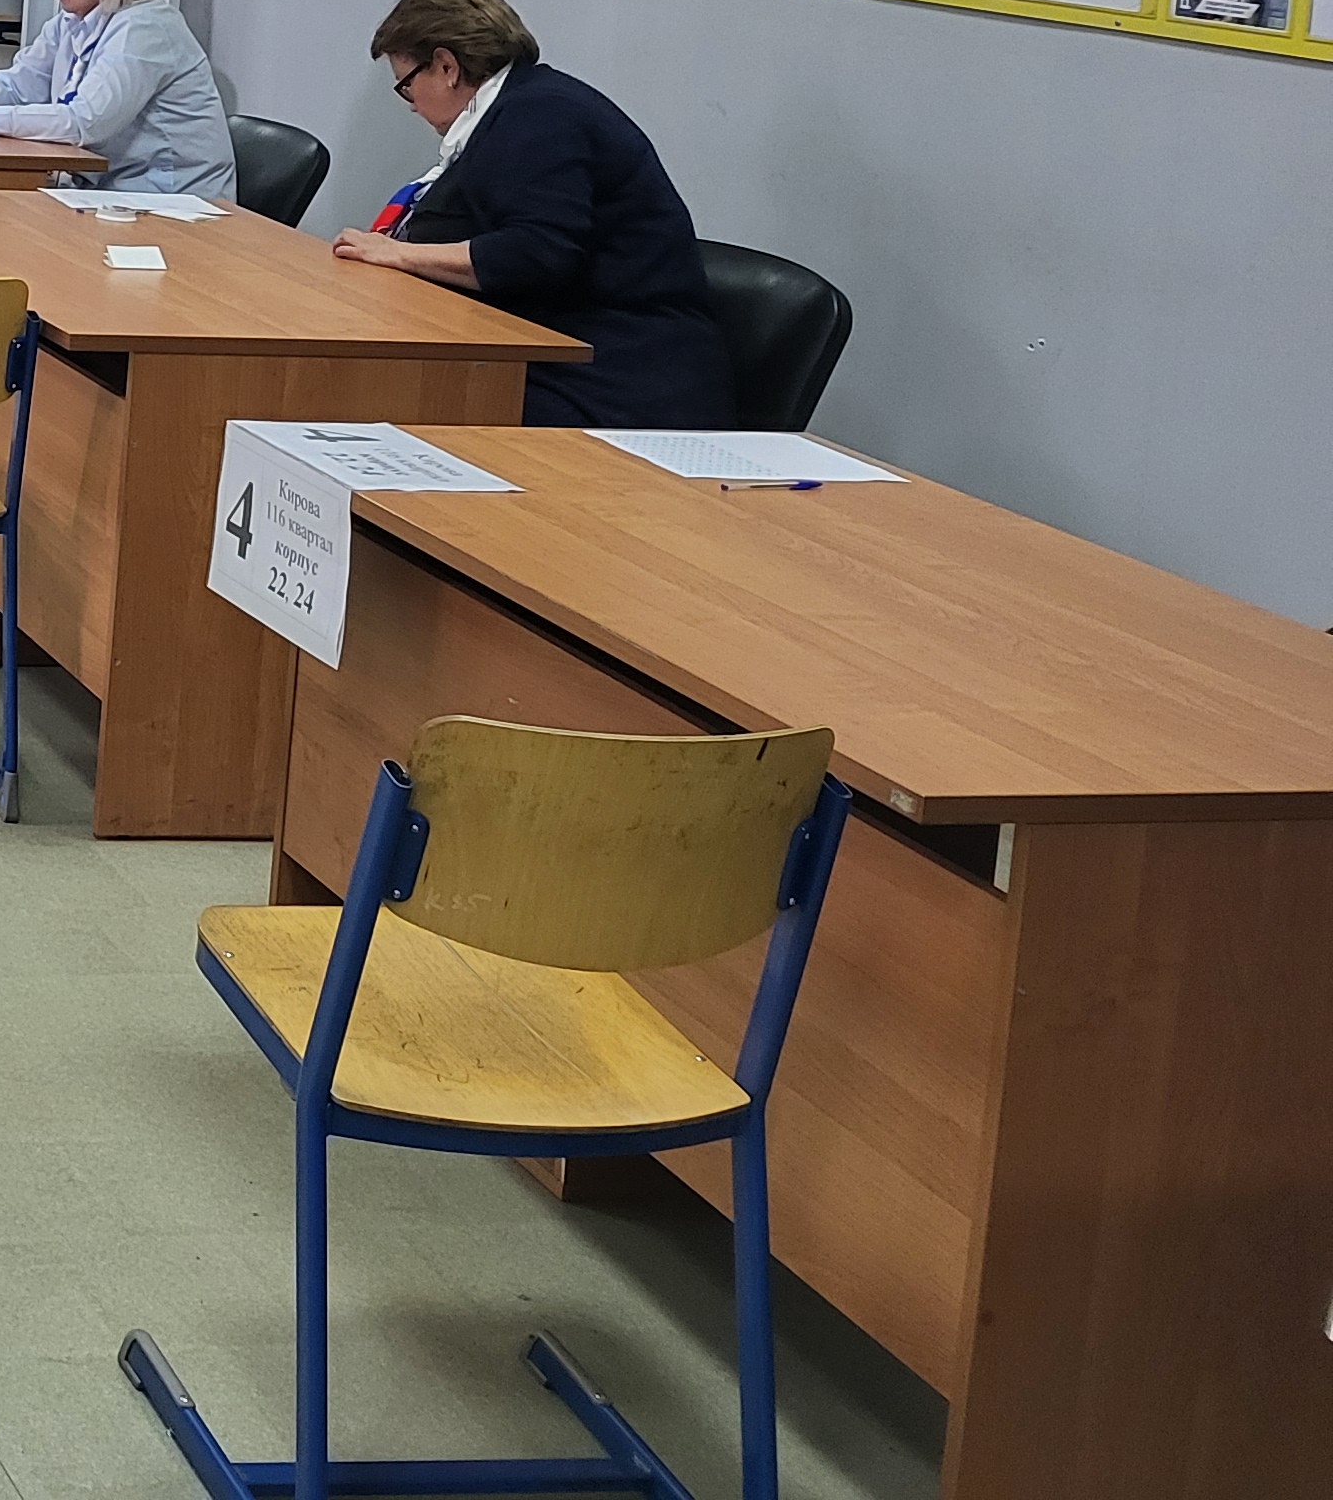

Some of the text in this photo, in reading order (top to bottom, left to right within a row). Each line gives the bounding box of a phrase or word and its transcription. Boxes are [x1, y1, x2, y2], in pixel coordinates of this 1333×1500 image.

[225, 481, 254, 561] 4
[278, 478, 321, 519] Кирова
[266, 500, 335, 556] 116 квартал
[274, 540, 320, 576] корпус
[266, 565, 316, 616] 22, 24
